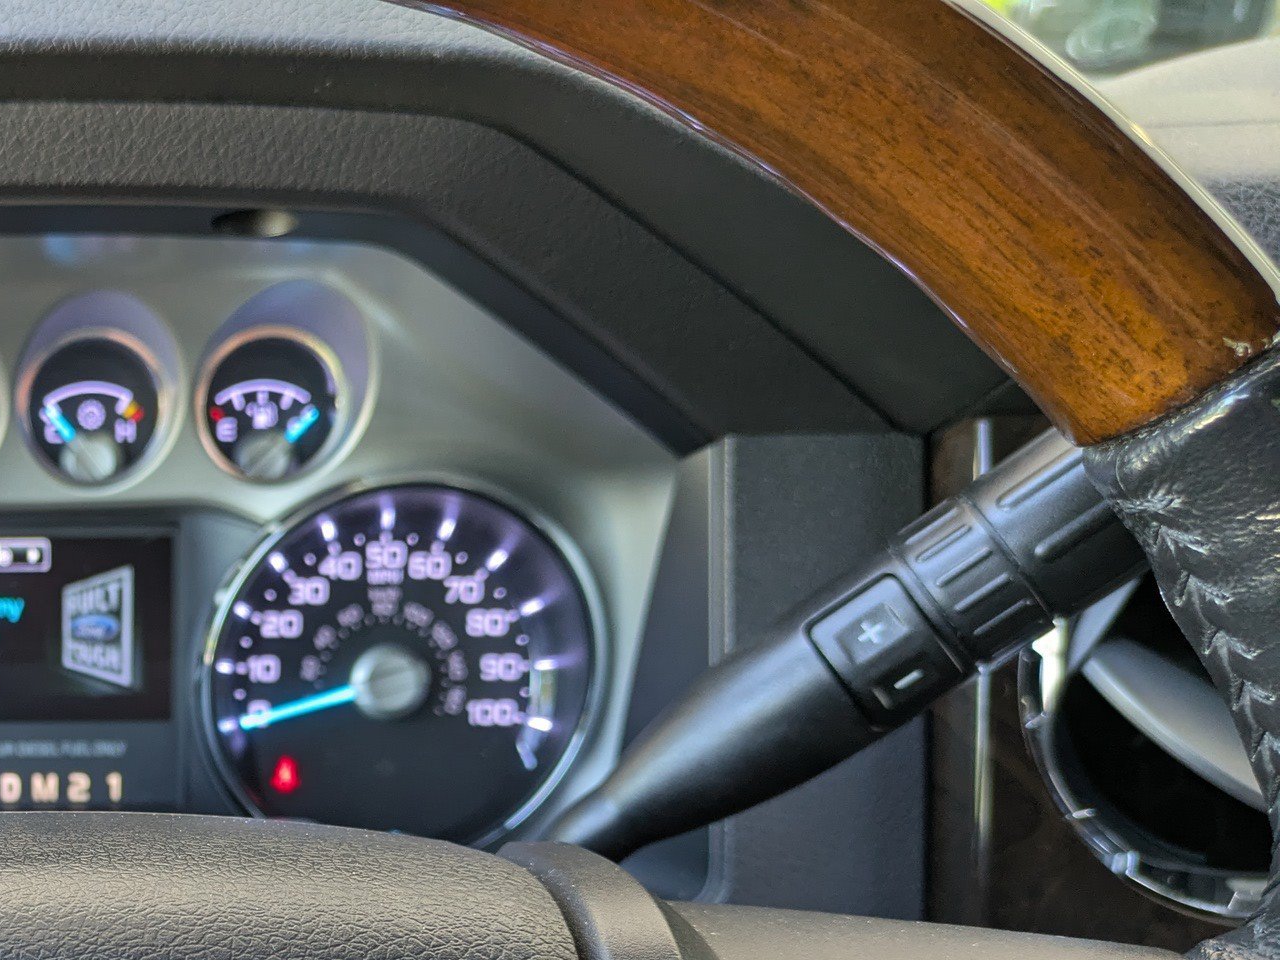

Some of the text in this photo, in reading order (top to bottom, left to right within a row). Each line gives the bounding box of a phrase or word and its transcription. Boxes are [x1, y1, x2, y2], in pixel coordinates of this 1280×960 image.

[318, 551, 363, 581] 40
[365, 540, 408, 569] 50
[407, 550, 452, 581] 60
[287, 576, 331, 606] 30
[443, 576, 486, 605] 70
[259, 609, 304, 639] 20
[465, 608, 510, 638] 80
[246, 654, 282, 683] 10
[479, 653, 523, 682] 90
[466, 698, 519, 728] 100
[30, 772, 59, 803] M
[66, 772, 91, 803] 2
[105, 771, 123, 802] 1
